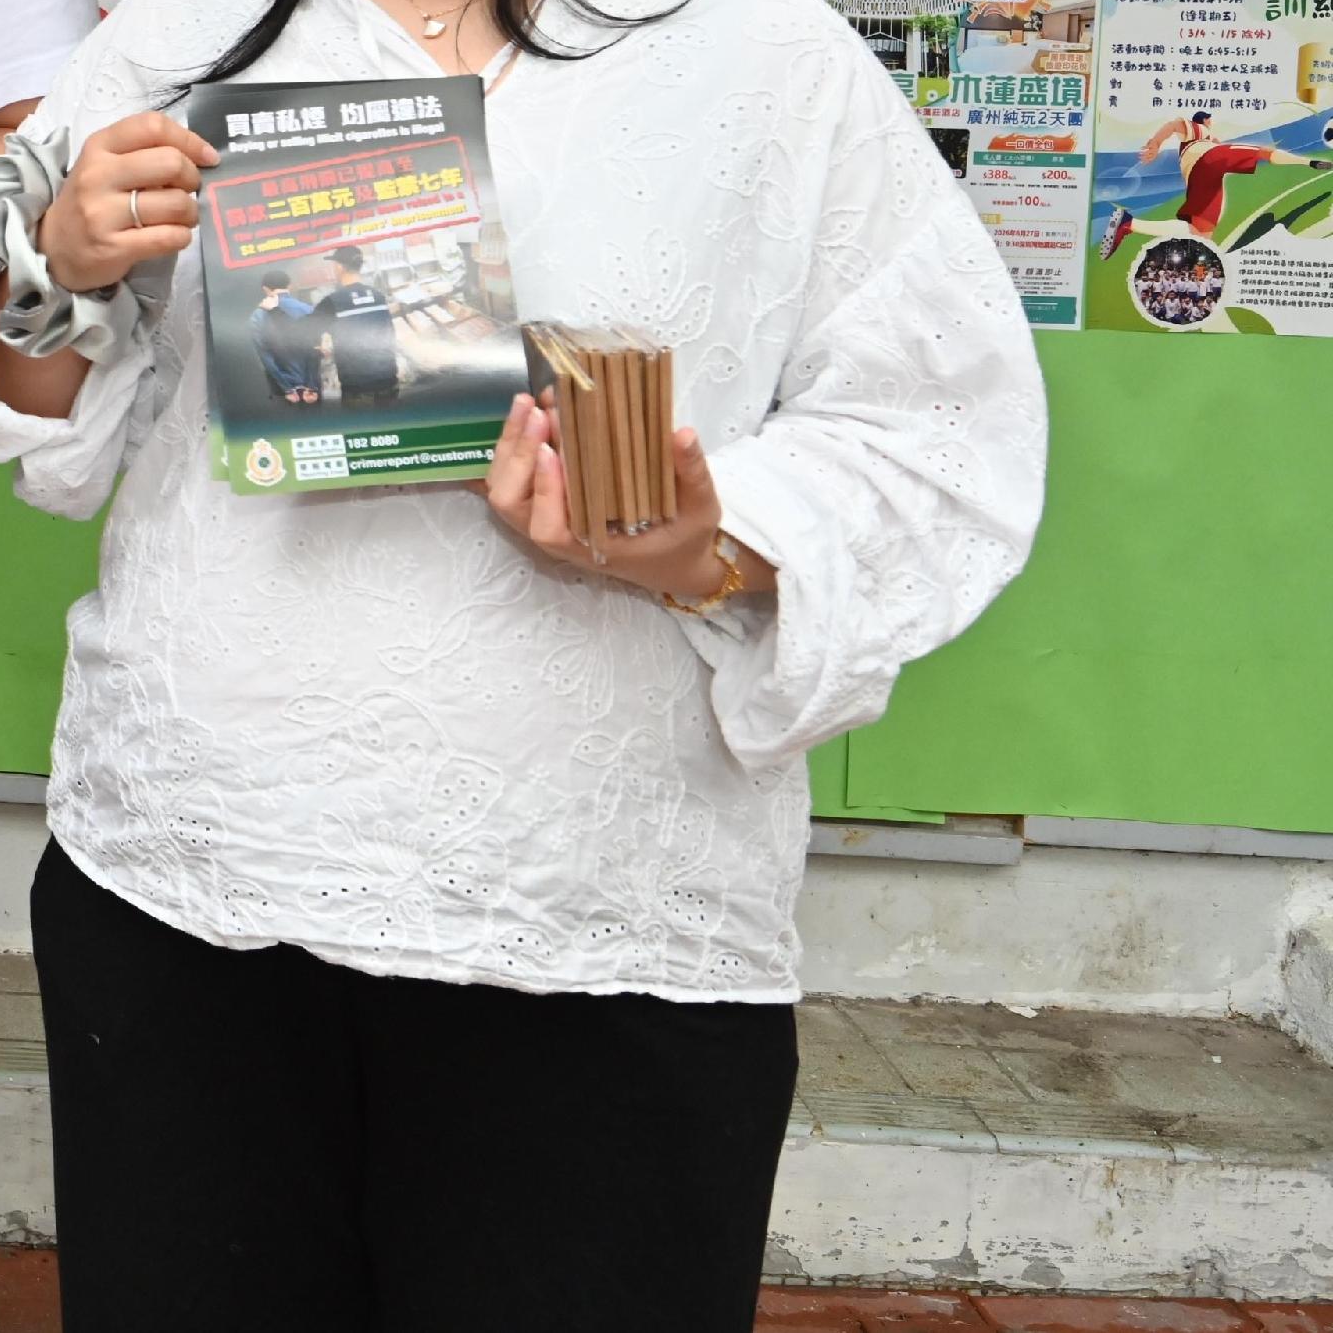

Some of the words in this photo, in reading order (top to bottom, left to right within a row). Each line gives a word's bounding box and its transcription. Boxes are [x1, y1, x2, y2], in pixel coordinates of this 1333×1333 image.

[951, 76, 1082, 106] 木蓮盛境
[226, 106, 327, 138] 買賣私煙
[340, 95, 443, 126] 均屬違法
[967, 110, 1083, 126] 廣州純玩2天團
